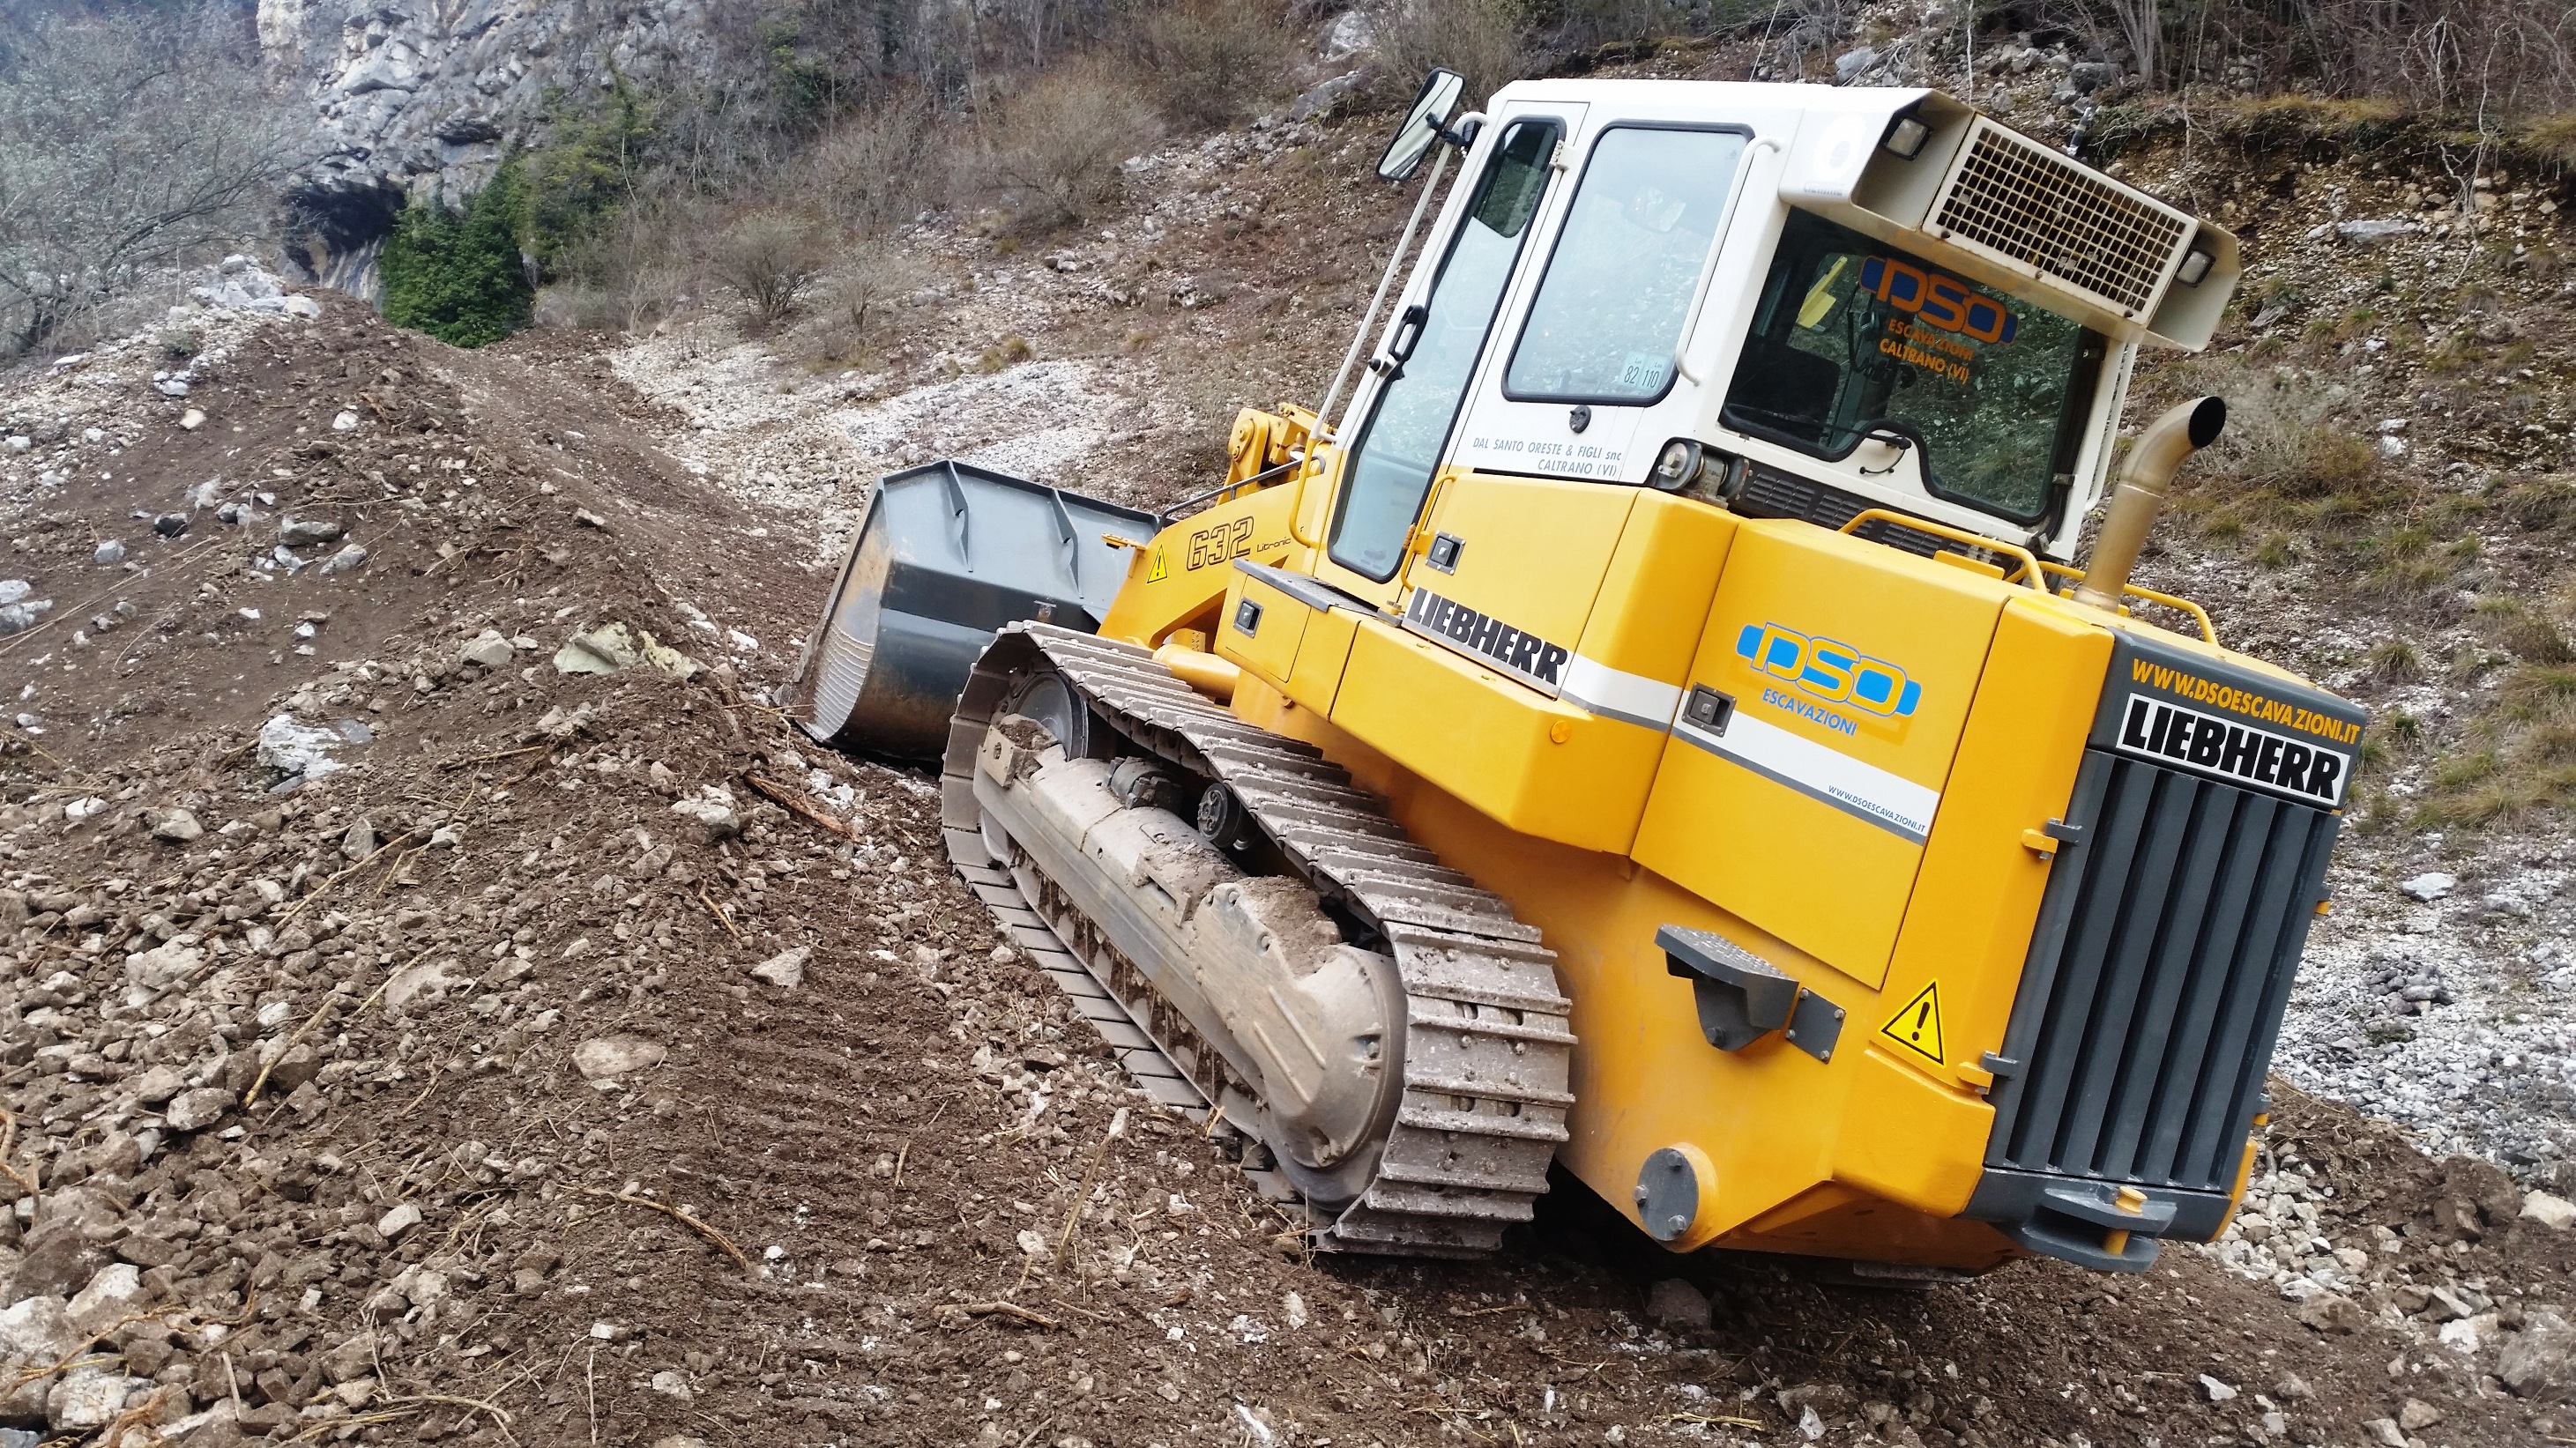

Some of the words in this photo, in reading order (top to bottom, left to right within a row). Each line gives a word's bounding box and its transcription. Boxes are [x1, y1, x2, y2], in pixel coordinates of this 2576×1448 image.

[1875, 256, 2007, 345] DSO
[1879, 338, 1947, 374] CALTRANO
[1947, 362, 1970, 385] (VI)
[1887, 318, 1975, 361] ESCAVAZIONI
[1623, 365, 1640, 384] 82
[1642, 369, 1660, 389] 110
[1472, 437, 1489, 449] DAL
[1493, 439, 1524, 452] SANTO
[1528, 442, 1563, 457] ORESTE
[1565, 445, 1574, 456] &
[1577, 446, 1604, 458] FIGLI
[1605, 450, 1622, 461] snc
[1537, 458, 1593, 475] CALTRANO
[1597, 464, 1618, 477] (VI)
[1186, 516, 1254, 572] 632
[1256, 536, 1292, 553] Litronic
[1407, 586, 1568, 686] LIEBHERR
[1749, 620, 1908, 718] DSO
[1761, 687, 1858, 737] ESCAVAZIONI
[2132, 657, 2361, 745] WWW.DSOESCAVAZIONI.IT
[2122, 698, 2341, 800] LIEBHERR
[1828, 784, 1926, 833] WWW.DSOESCAVAZIONI.IT
